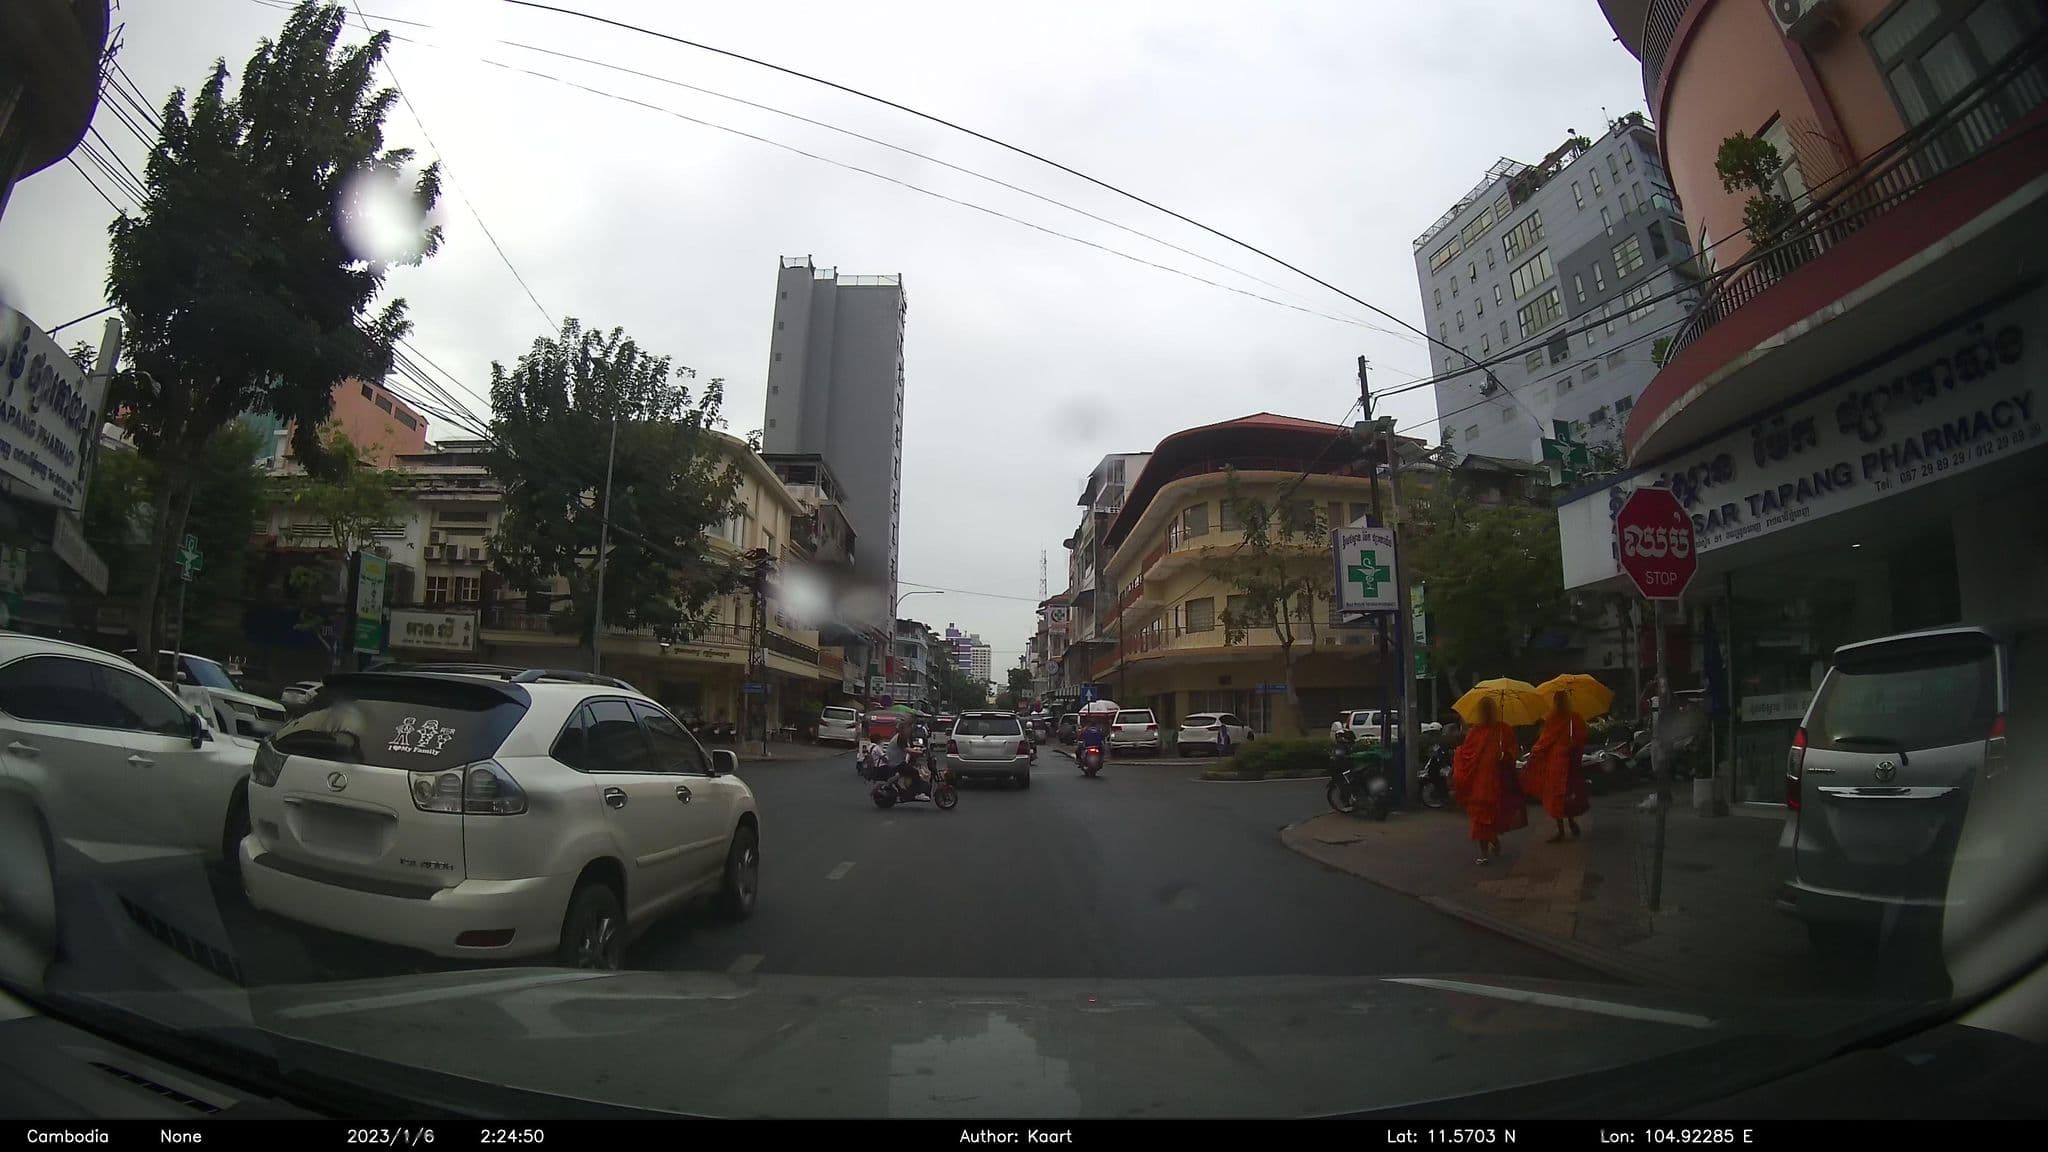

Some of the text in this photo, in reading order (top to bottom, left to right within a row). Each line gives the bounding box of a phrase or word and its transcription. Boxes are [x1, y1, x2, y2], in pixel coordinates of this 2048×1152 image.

[1691, 389, 2033, 534] SAR TAPANG PHARMACY
[1900, 468, 1917, 485] 087
[1921, 463, 1934, 479] 29
[1936, 458, 1950, 472] 89
[1952, 451, 1966, 466] 29
[1976, 440, 1993, 457] 012
[1646, 571, 1678, 585] STOP
[413, 746, 441, 756] Family
